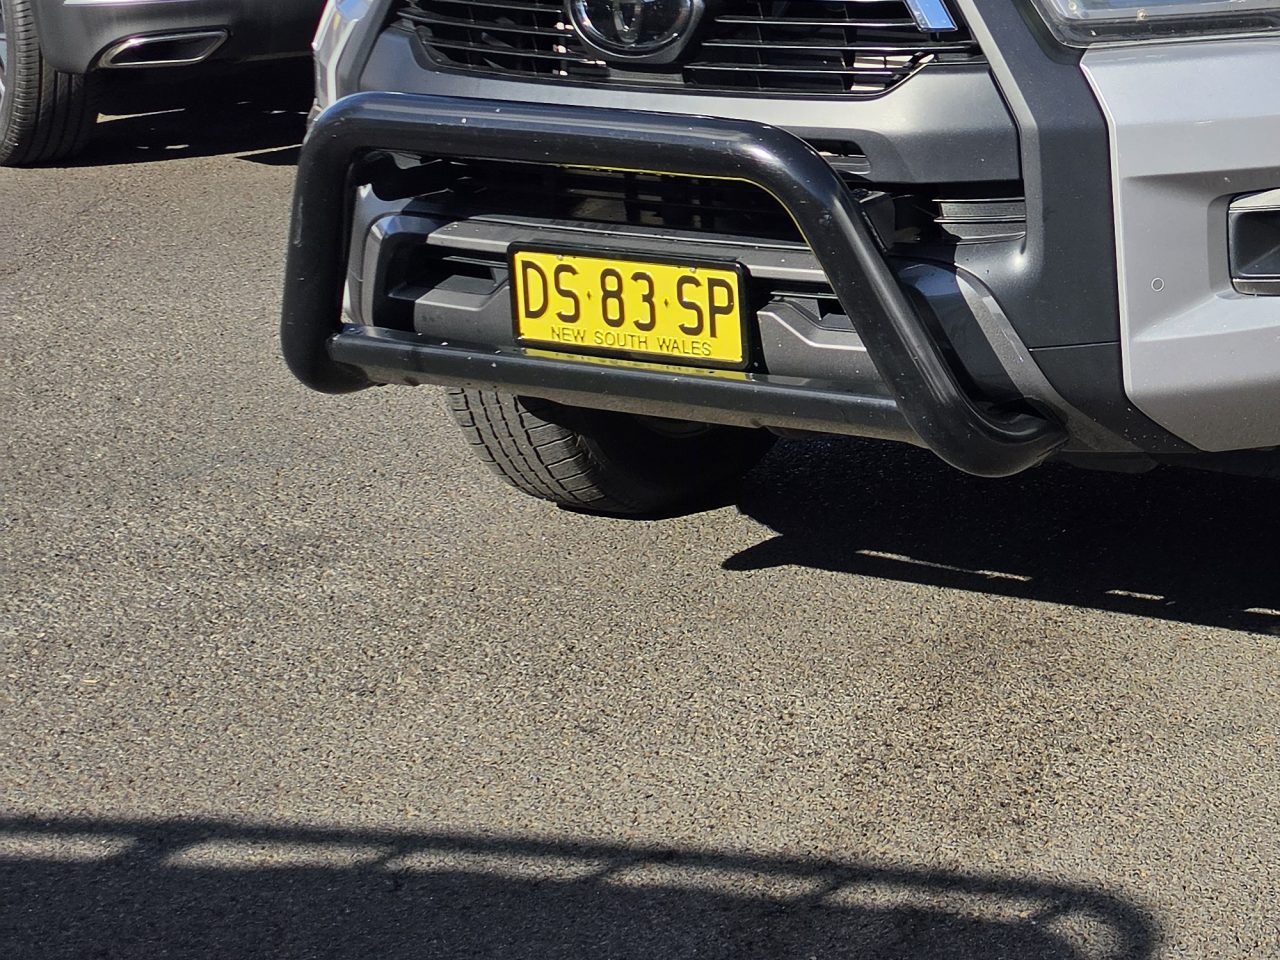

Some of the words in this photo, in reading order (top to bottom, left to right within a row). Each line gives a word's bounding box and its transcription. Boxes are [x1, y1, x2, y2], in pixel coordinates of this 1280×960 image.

[550, 326, 586, 344] NEW
[594, 331, 648, 350] SOUTH
[657, 337, 712, 356] WALES
